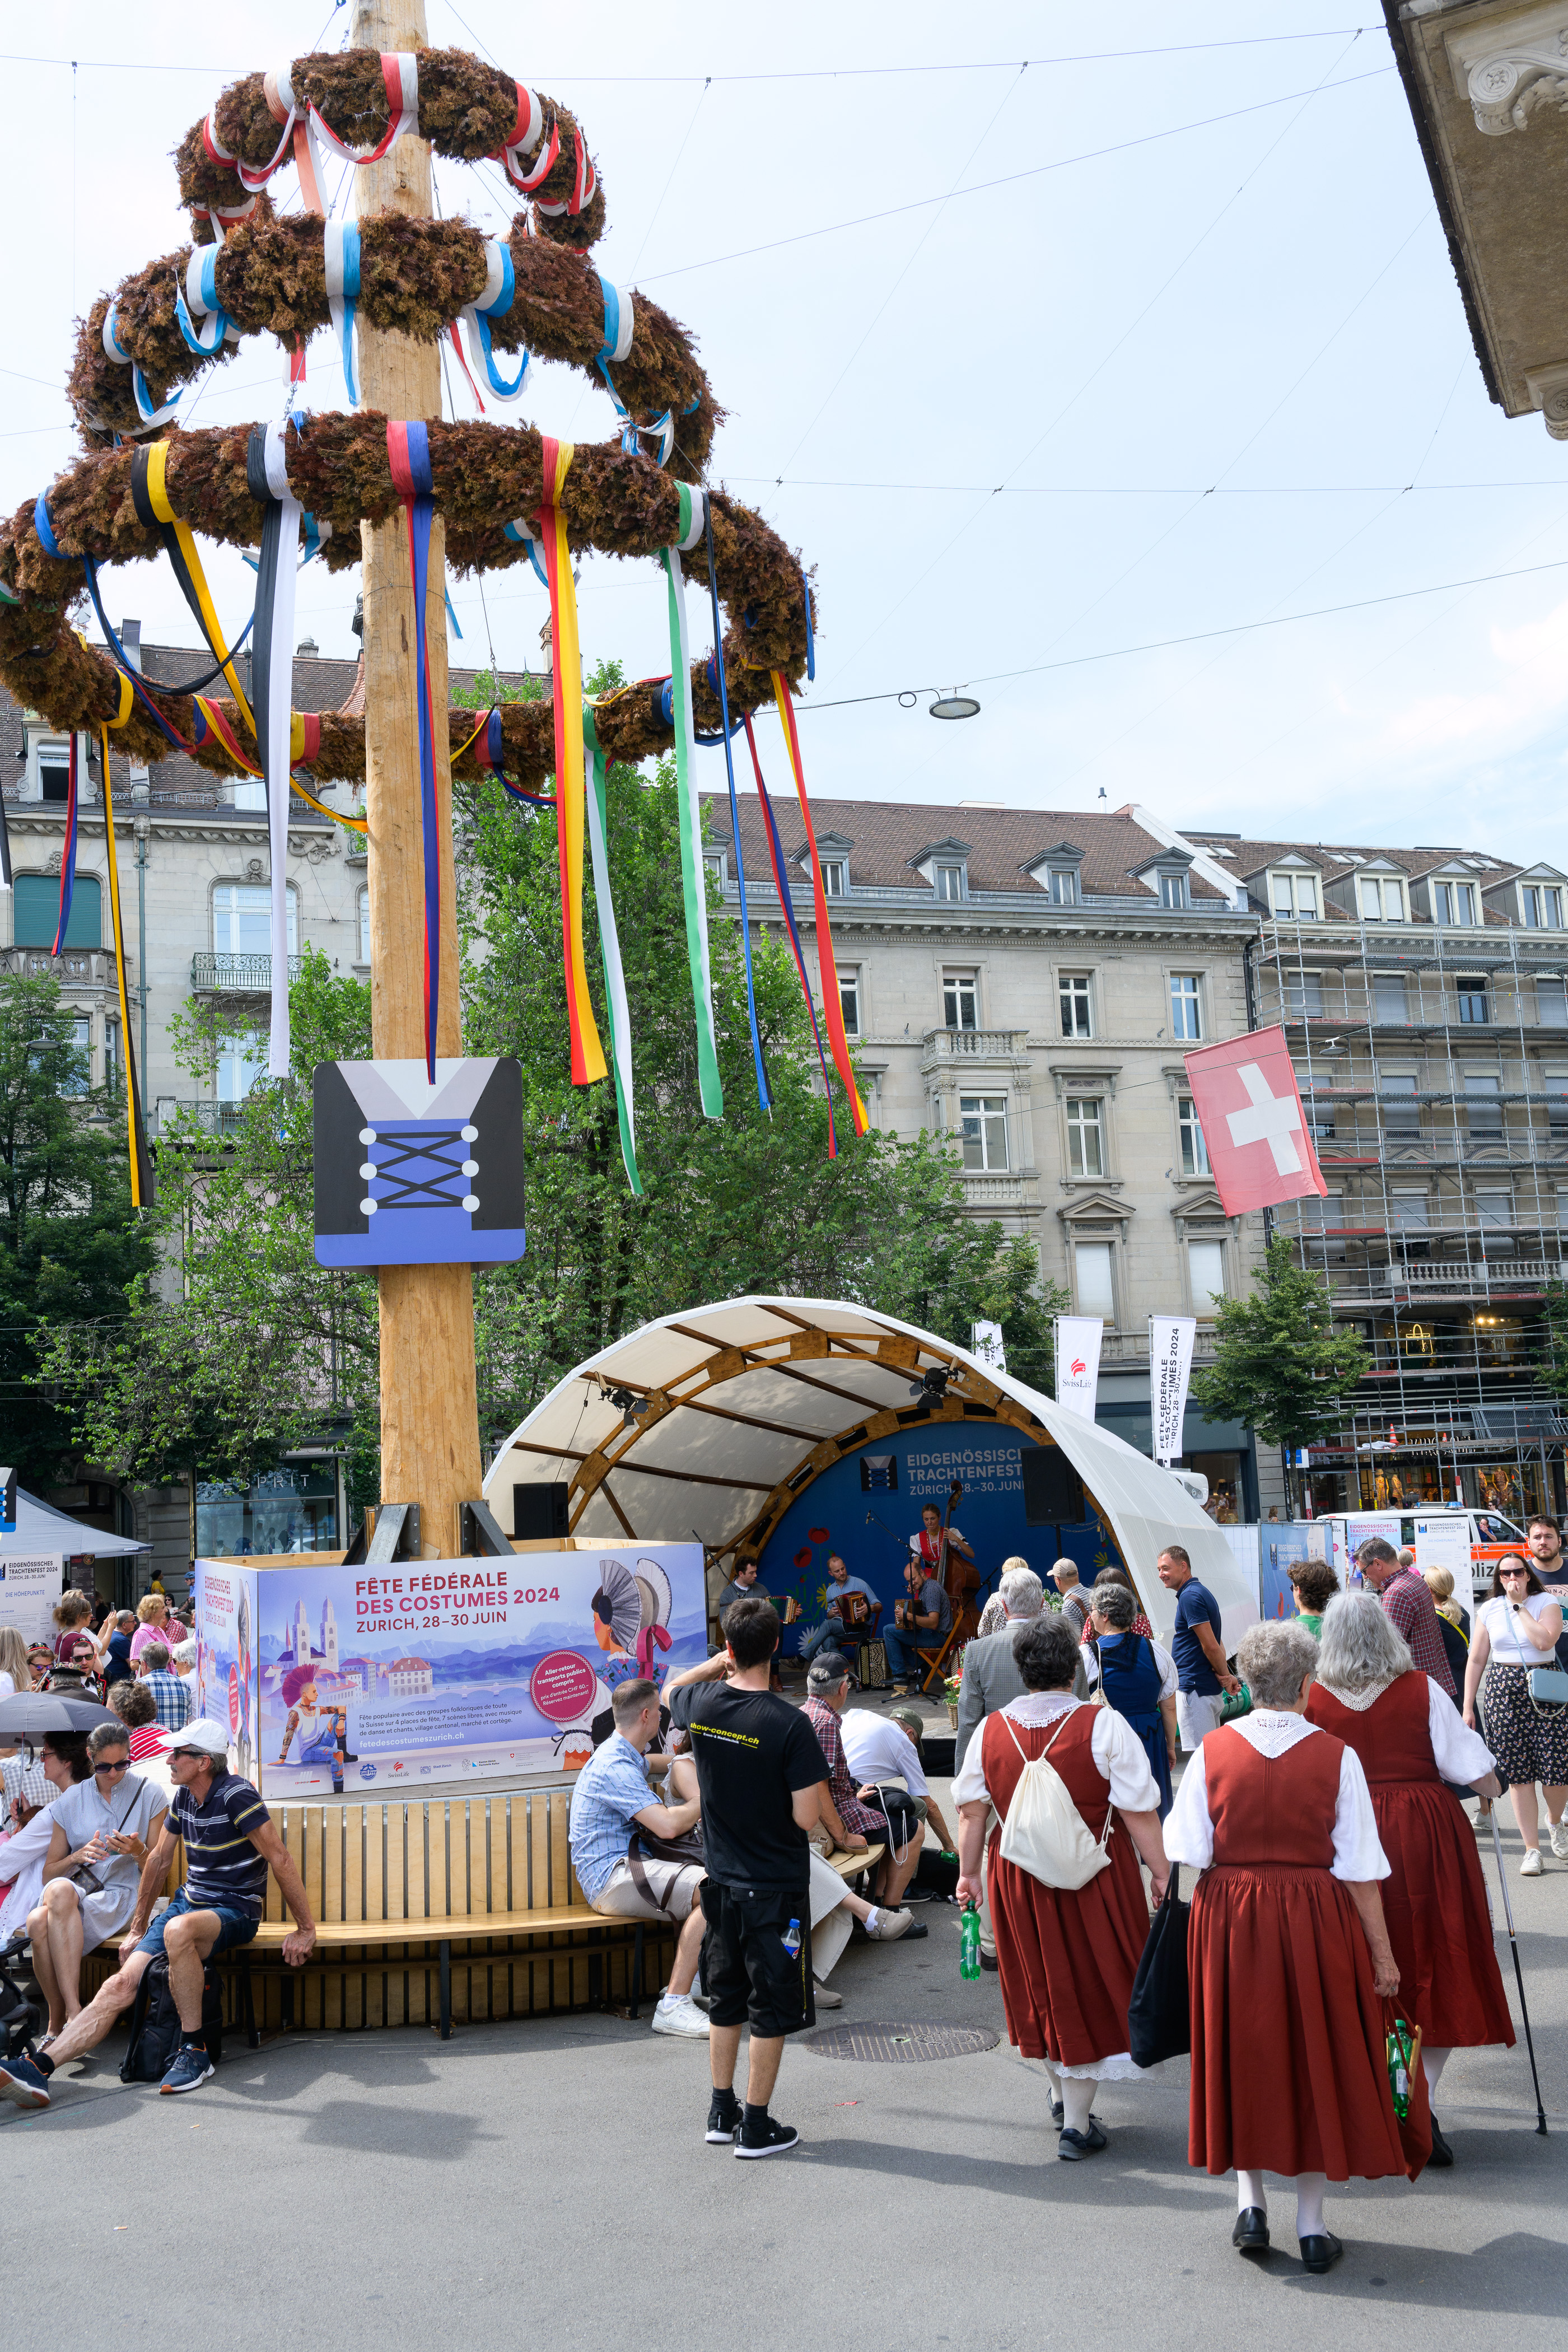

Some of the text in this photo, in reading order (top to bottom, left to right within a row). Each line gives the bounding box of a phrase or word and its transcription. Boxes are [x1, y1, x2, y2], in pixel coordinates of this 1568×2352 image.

[1170, 1328, 1179, 1356] 2024
[1062, 1379, 1091, 1388] SwissLife
[907, 1463, 1023, 1481] TRACHTENFEST
[205, 1575, 231, 1595] EIDGENÖSSISCHES
[356, 1571, 507, 1596] FÊTE FÉDÉRALE
[205, 1593, 226, 1612] TRACHTENFEST
[356, 1586, 560, 1615] DES COSTUMES 2024
[356, 1617, 419, 1633] ZURICH,
[472, 1611, 507, 1625] JUIN
[537, 1668, 586, 1685] transports publics
[545, 1664, 576, 1676] Aller-retour
[552, 1678, 574, 1688] compris
[543, 1690, 589, 1706] Réservez maintenant!
[373, 1712, 400, 1720] populaire
[359, 1732, 464, 1748] fetedescostumeszurich.ch
[690, 1722, 760, 1744] show-concept.ch
[717, 1735, 739, 1744] Mediatechnik
